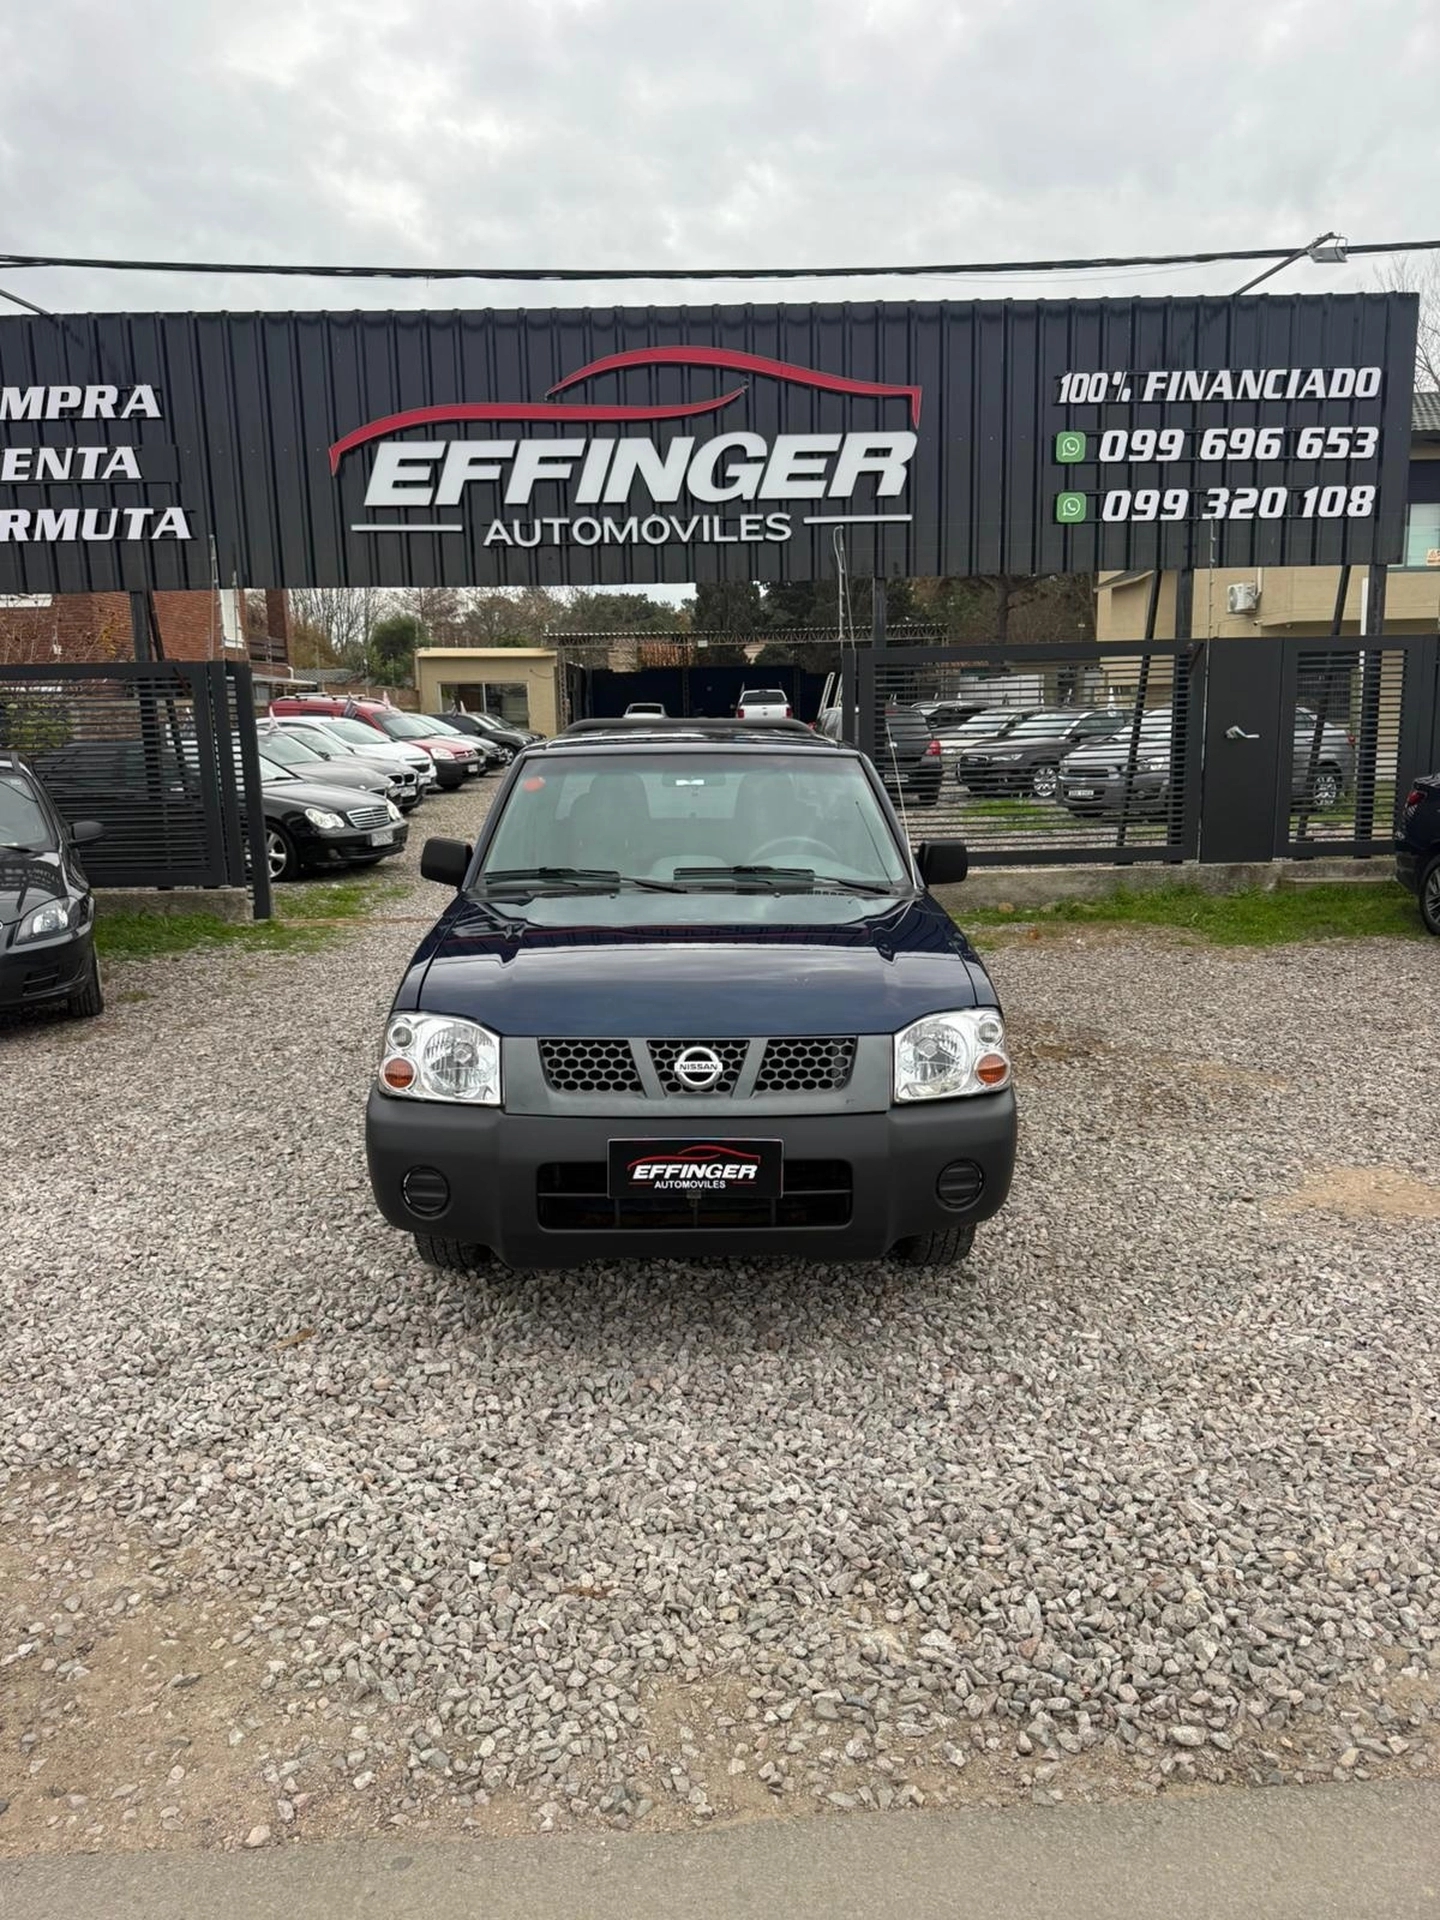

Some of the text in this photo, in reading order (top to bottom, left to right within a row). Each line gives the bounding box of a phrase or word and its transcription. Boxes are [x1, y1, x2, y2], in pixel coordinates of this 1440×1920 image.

[1058, 367, 1382, 404] 100% FINANCIADO
[1099, 426, 1380, 463] 099 696 653
[1, 446, 142, 481] ENTA
[363, 430, 918, 508] EFFINGER
[1102, 485, 1376, 522] 099 320 108
[679, 1062, 718, 1071] NISSAN
[632, 1163, 758, 1180] EFFINGER
[654, 1180, 726, 1189] AUTOMOVILES
